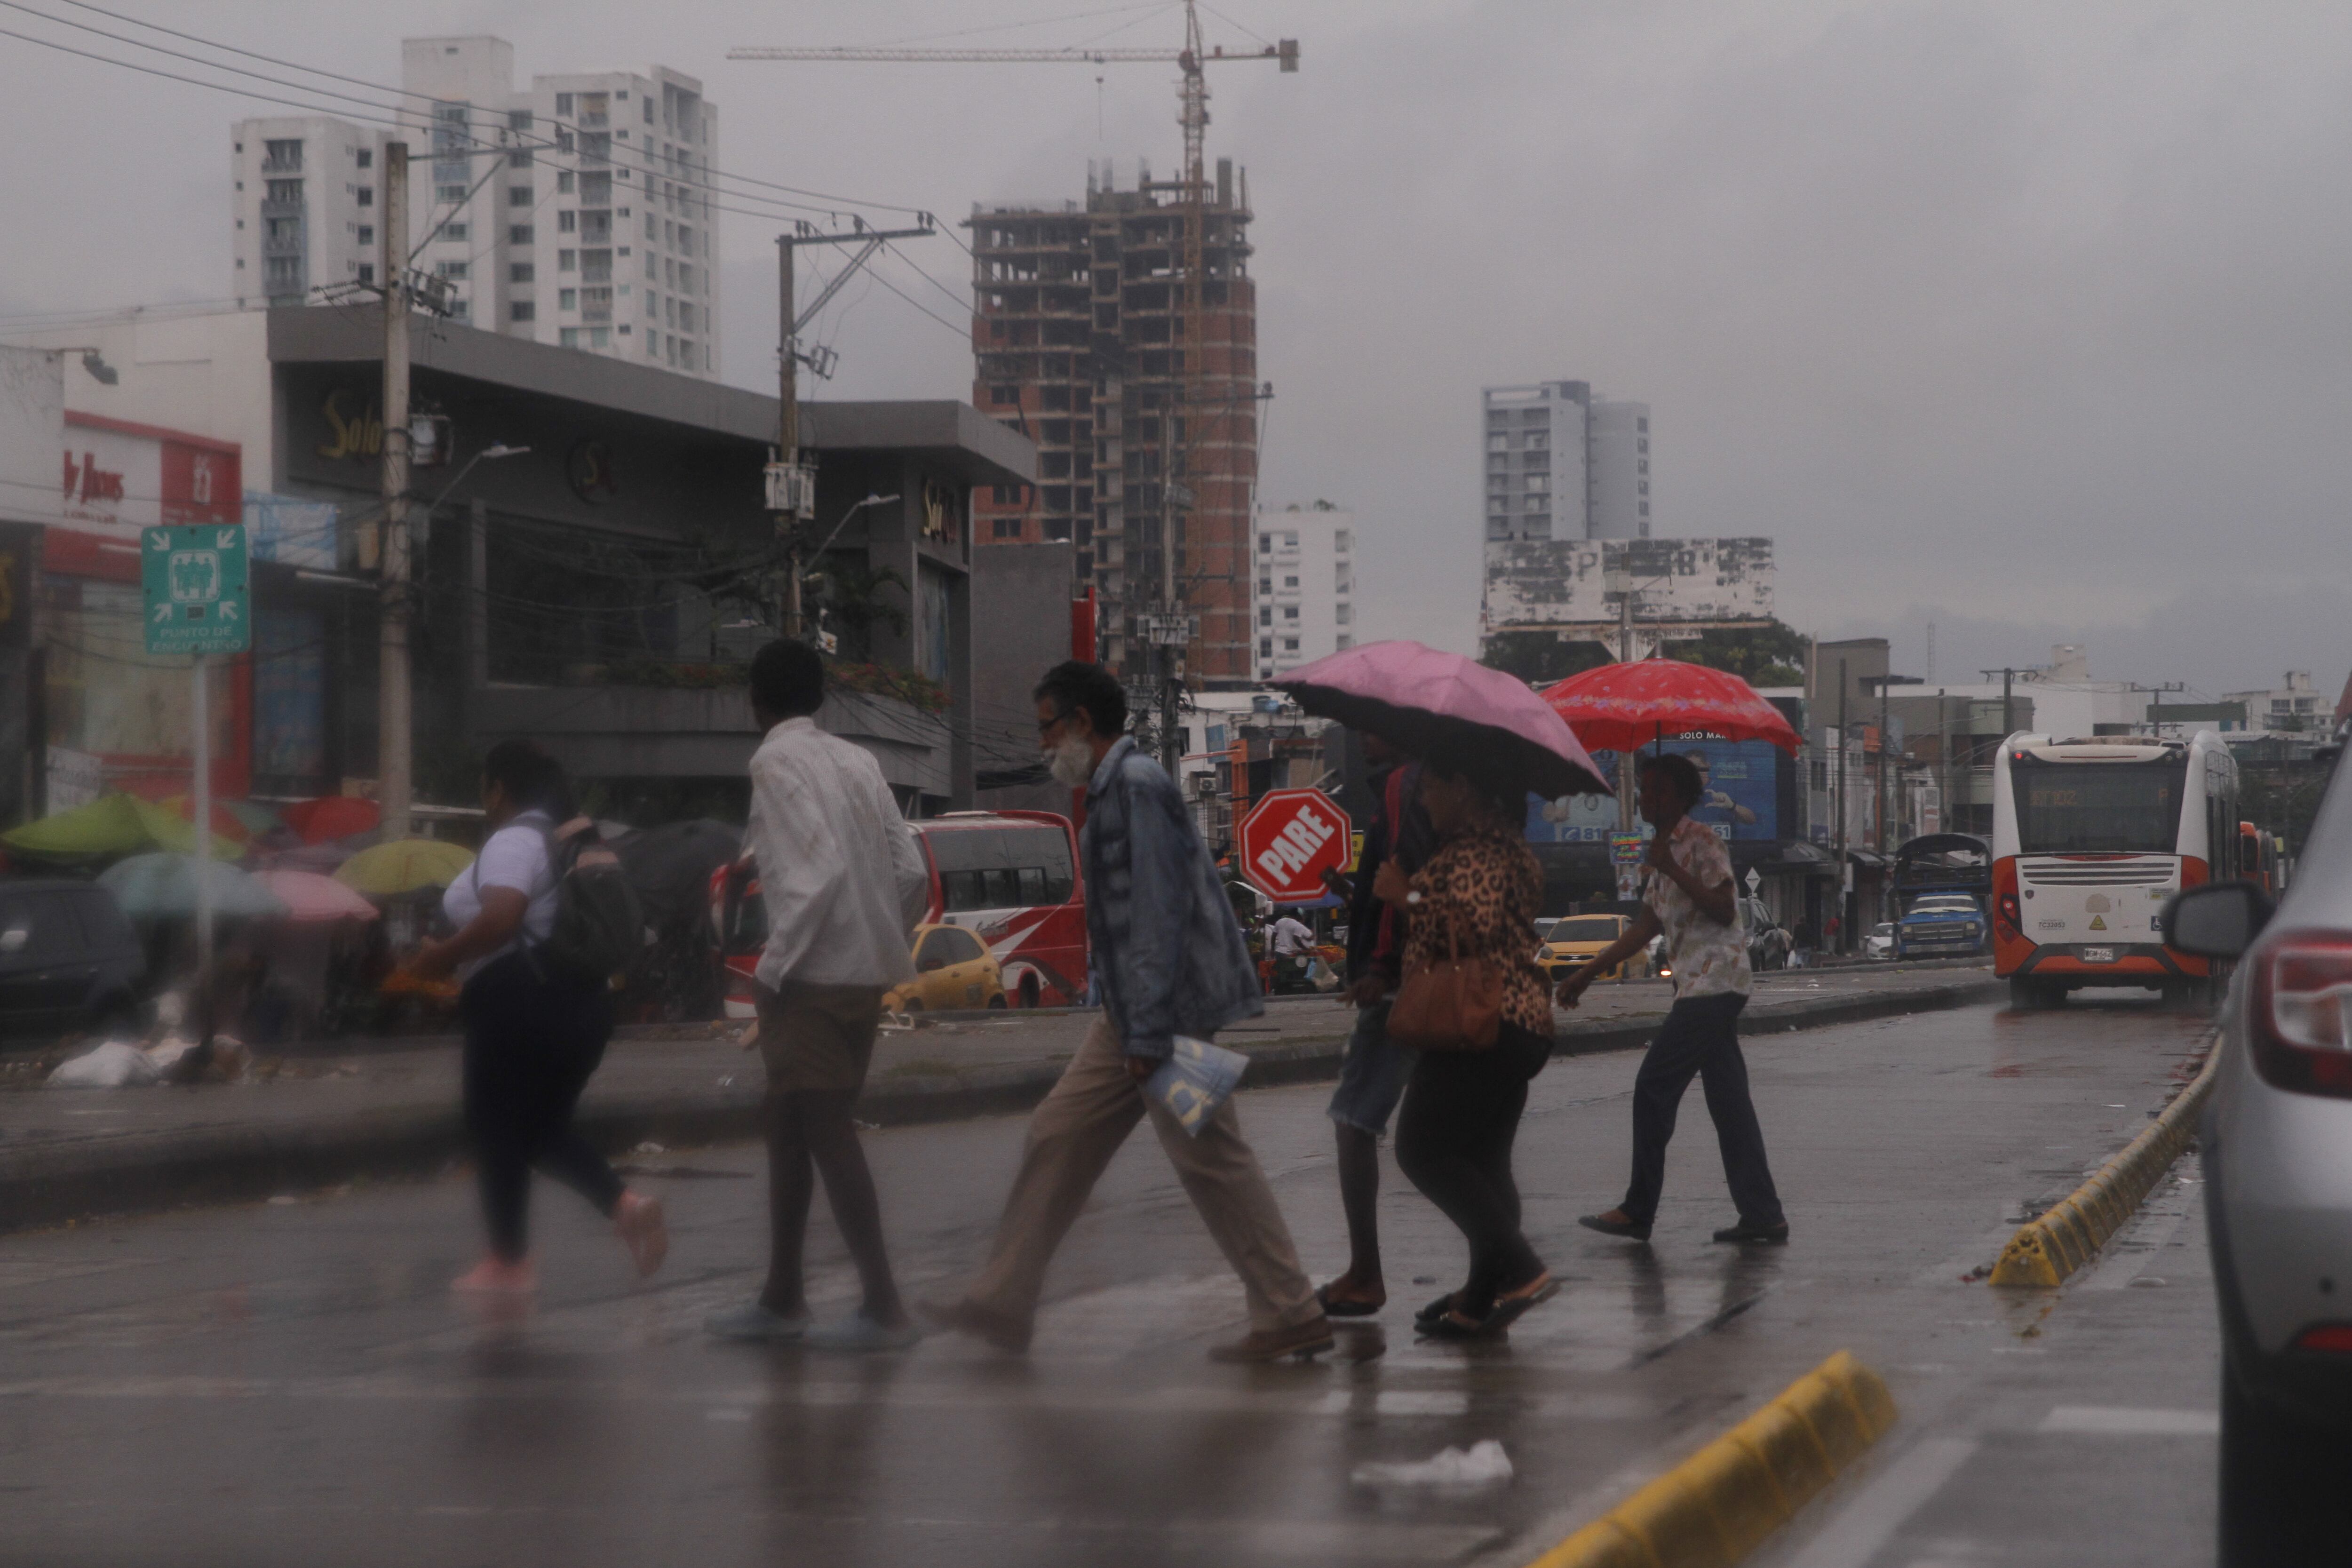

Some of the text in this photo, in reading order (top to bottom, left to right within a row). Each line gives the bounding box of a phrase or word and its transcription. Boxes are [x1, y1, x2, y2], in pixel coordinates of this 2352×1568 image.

[160, 626, 233, 638] PUNTO DE
[1584, 828, 1602, 840] 81
[1256, 804, 1335, 886] PARE
